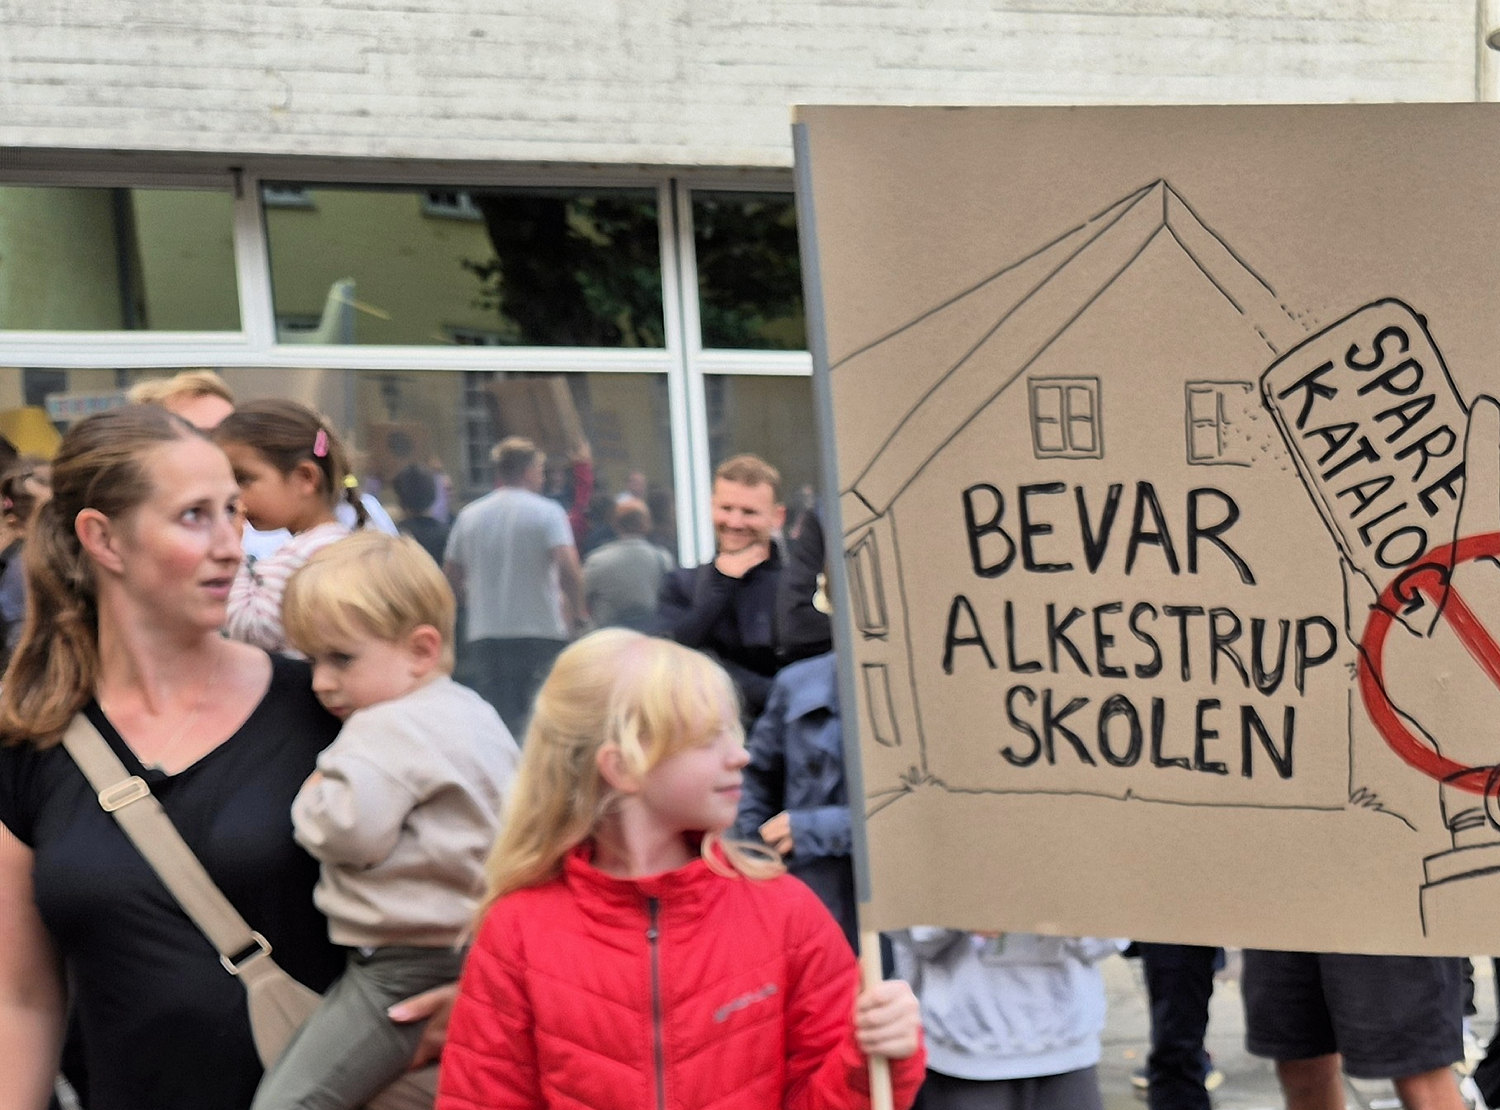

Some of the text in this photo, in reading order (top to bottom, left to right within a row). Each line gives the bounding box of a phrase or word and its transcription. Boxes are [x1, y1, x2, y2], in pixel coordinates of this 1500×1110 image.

[1344, 326, 1466, 517] SPARE
[962, 480, 1256, 585] BEVAR
[1278, 360, 1450, 615] KATALOG
[942, 594, 1338, 697] ALKESTRUP
[1001, 684, 1297, 779] SKOLEN
